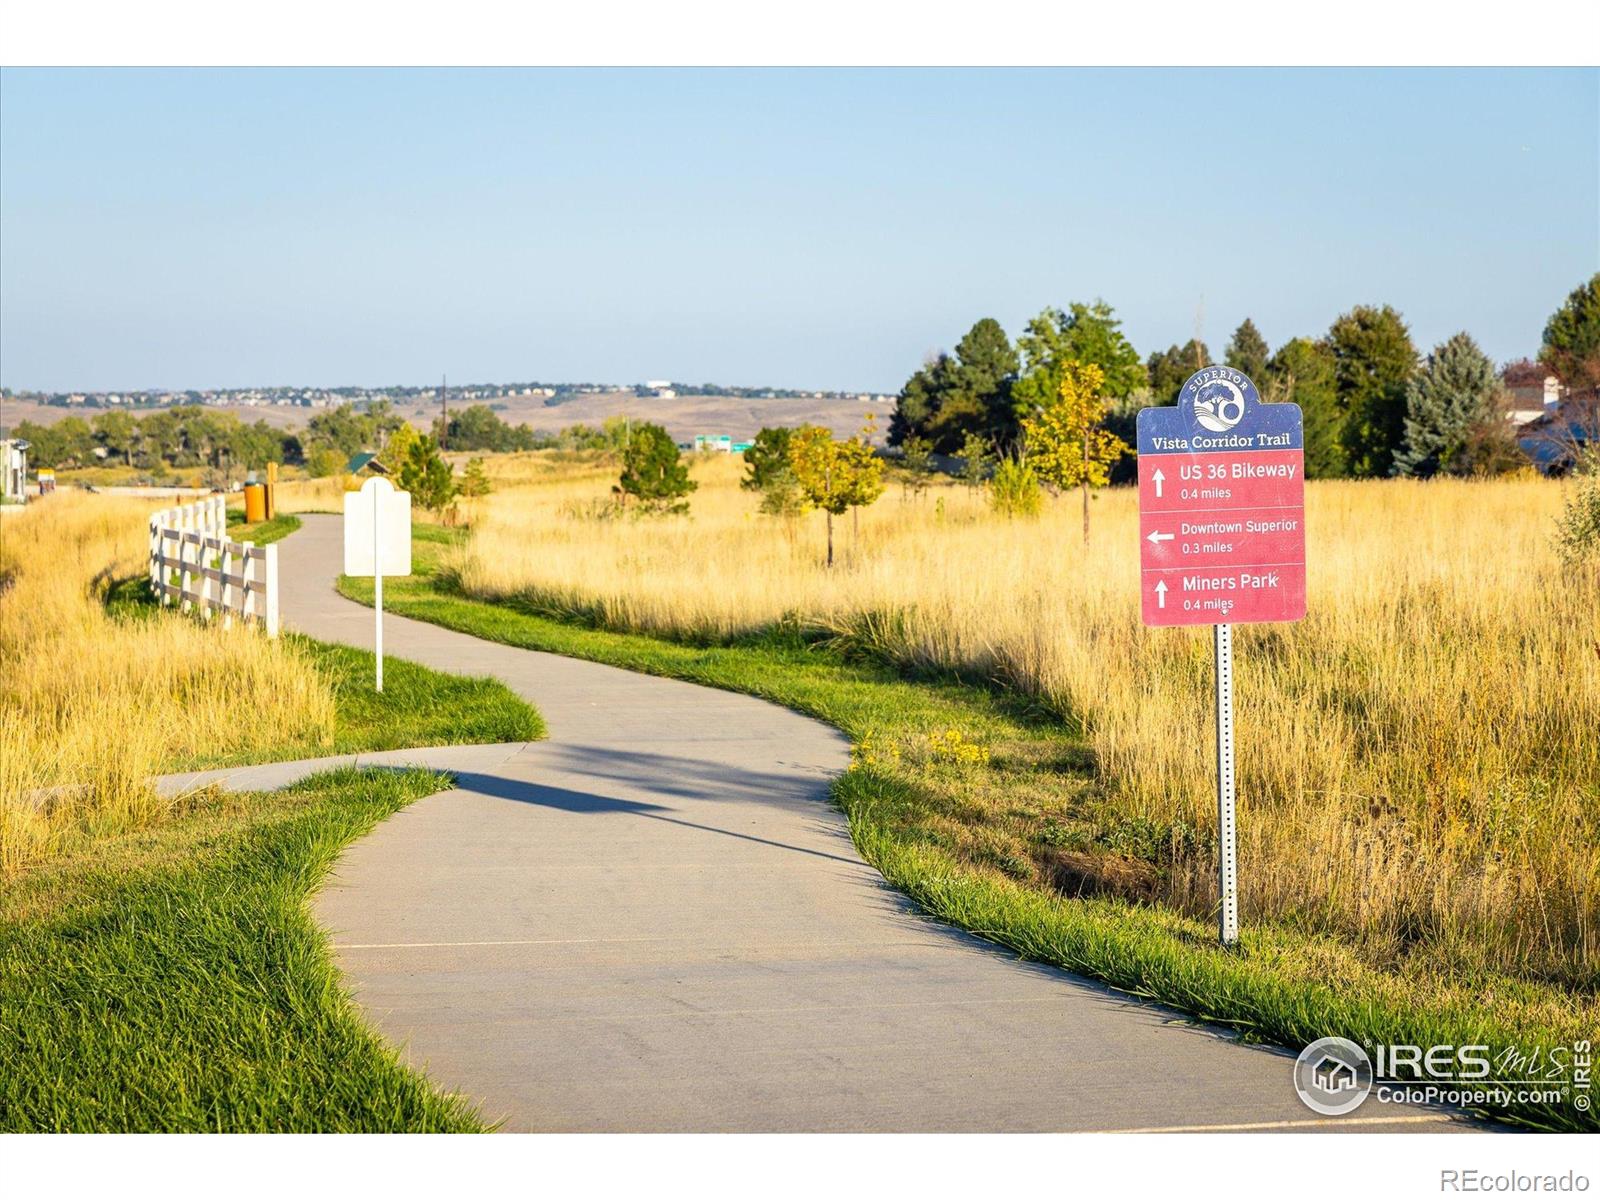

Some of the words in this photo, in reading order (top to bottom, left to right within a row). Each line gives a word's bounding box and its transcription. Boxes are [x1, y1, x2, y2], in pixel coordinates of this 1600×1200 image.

[1189, 370, 1248, 392] SUPERIOR
[1152, 437, 1188, 450] Vista
[1192, 434, 1253, 449] Corridor
[1257, 433, 1290, 446] Trail
[1180, 465, 1202, 480] US
[1207, 464, 1227, 478] 36
[1231, 462, 1296, 479] Bikeway
[1181, 489, 1198, 499] 0.4
[1201, 488, 1231, 498] miles
[1181, 522, 1242, 535] Downtown
[1246, 519, 1297, 533] Superior
[1182, 543, 1199, 554] 0.3
[1203, 542, 1233, 553] miles
[1183, 575, 1236, 591] Miners
[1240, 573, 1278, 589] Park
[1184, 600, 1201, 610] 0.4
[1204, 598, 1233, 609] miles
